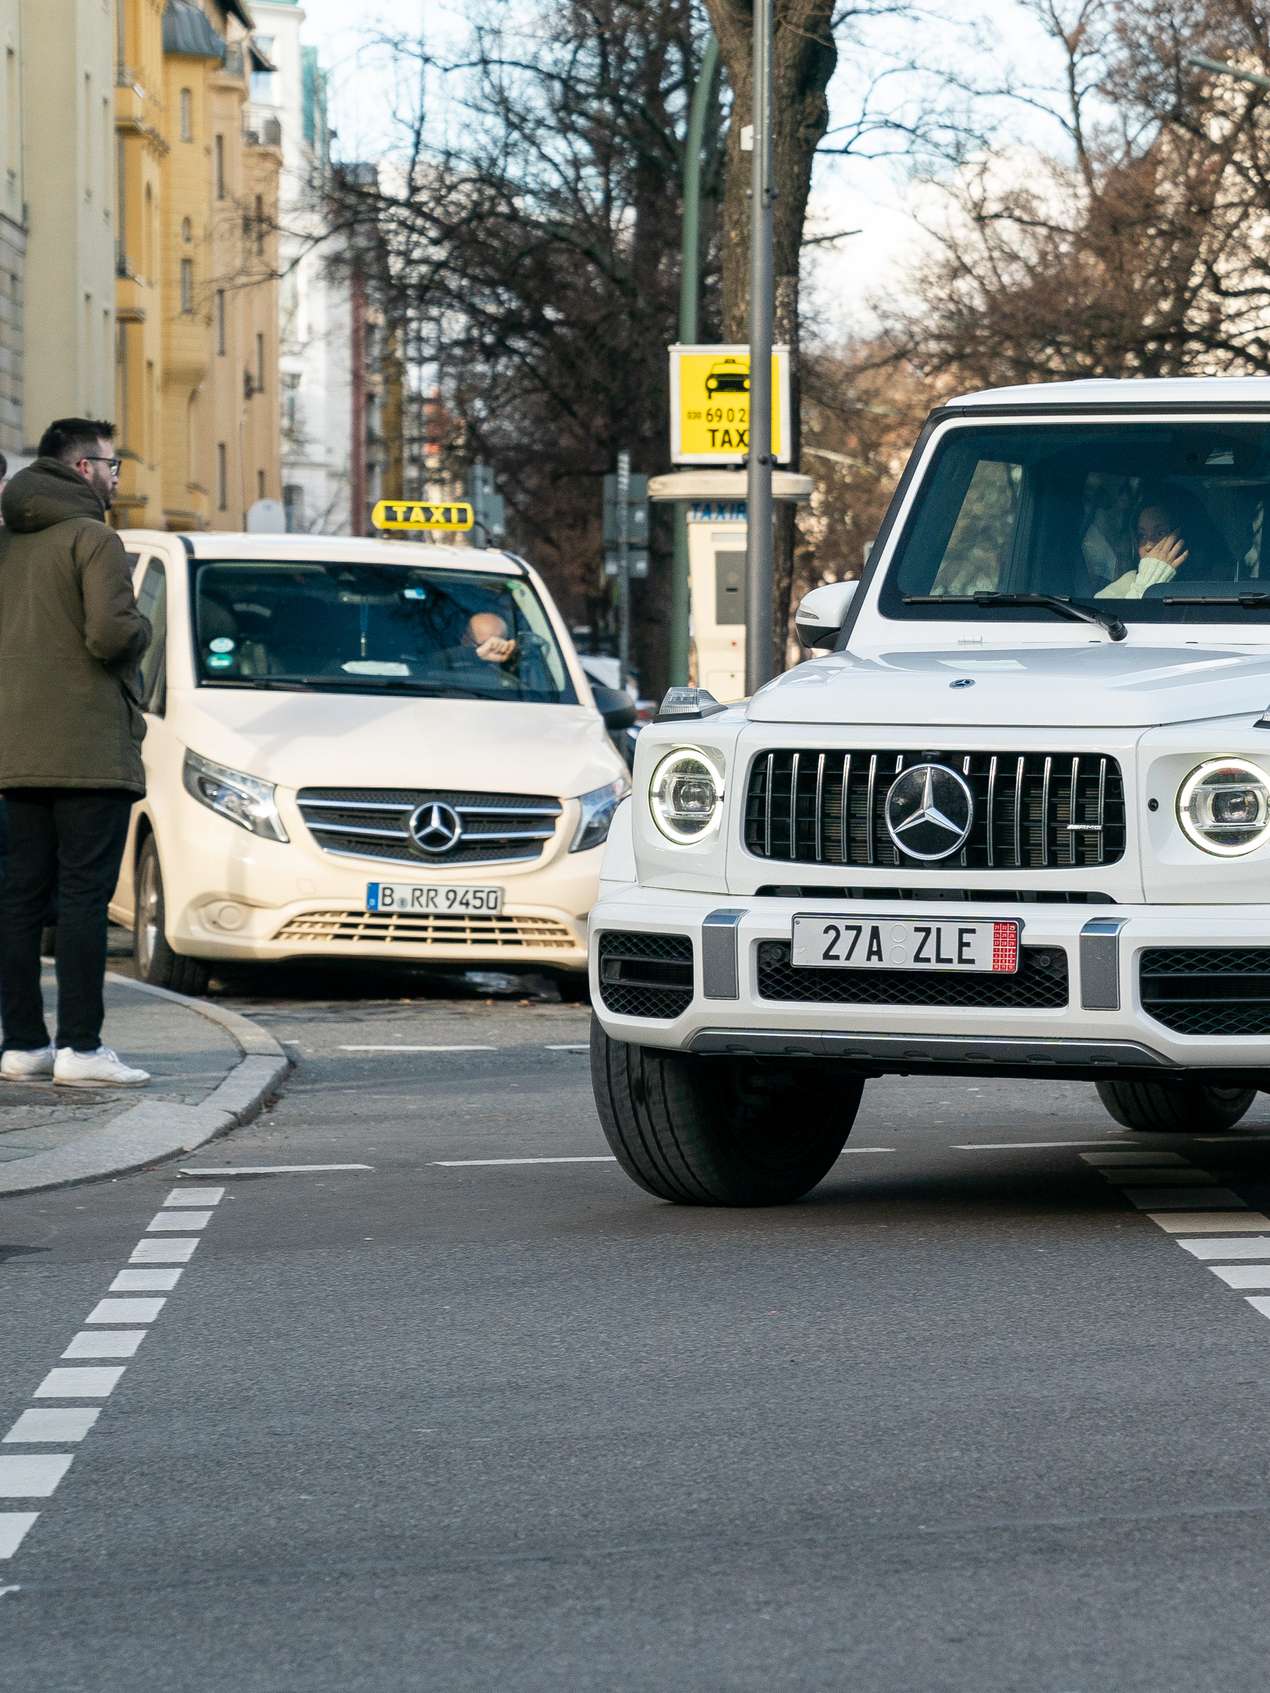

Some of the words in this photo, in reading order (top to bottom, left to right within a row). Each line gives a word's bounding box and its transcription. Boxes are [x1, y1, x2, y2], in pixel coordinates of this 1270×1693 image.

[707, 428, 750, 447] TAX
[392, 505, 459, 524] TAXI
[691, 503, 747, 520] TAXIR
[381, 887, 394, 907] B
[411, 888, 438, 908] RR
[445, 889, 499, 910] 9450
[822, 924, 884, 962] 27A
[913, 926, 977, 965] ZLE
